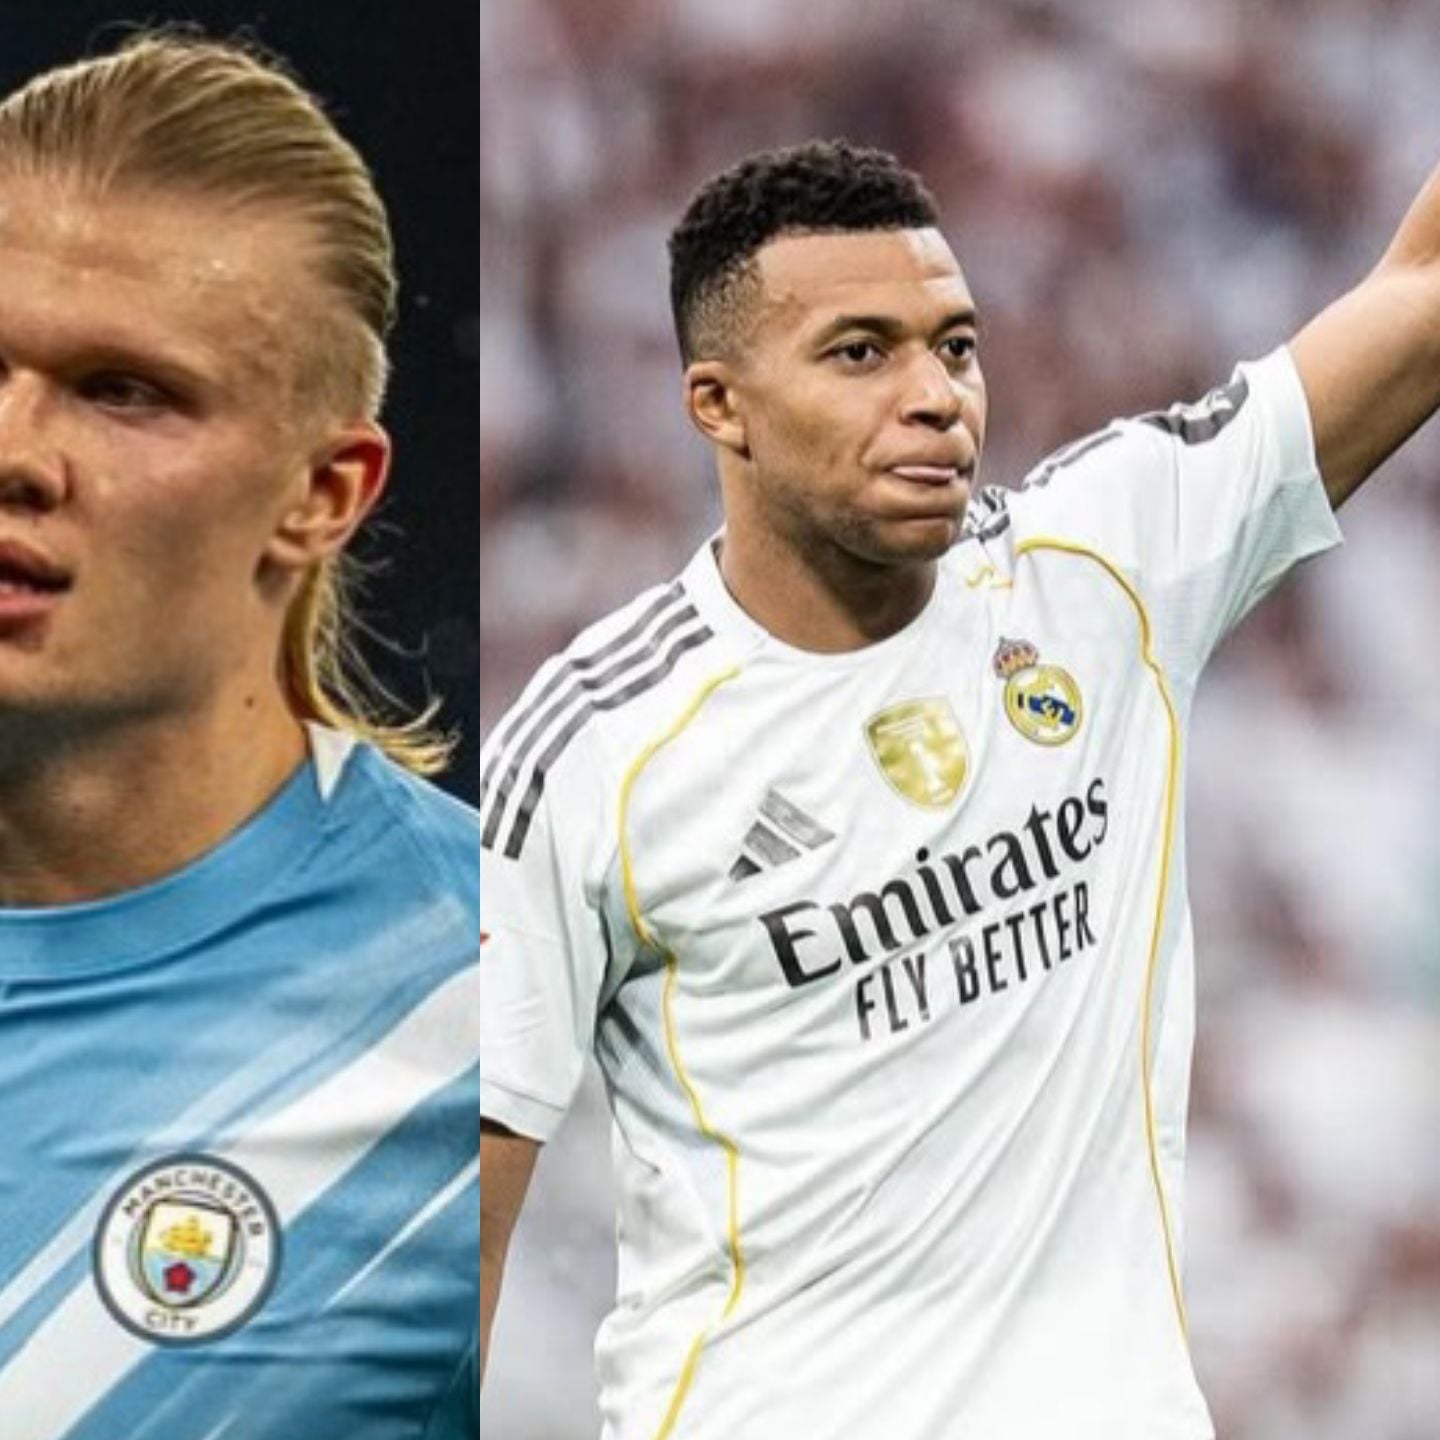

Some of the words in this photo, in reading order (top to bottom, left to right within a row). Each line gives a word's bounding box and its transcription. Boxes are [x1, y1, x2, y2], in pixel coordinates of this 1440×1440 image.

[758, 777, 1109, 987] Emirates
[856, 952, 931, 1040] FLY
[949, 881, 1097, 1005] BETTER
[122, 1170, 264, 1235] MANCHESTER
[146, 1312, 197, 1330] CITY
